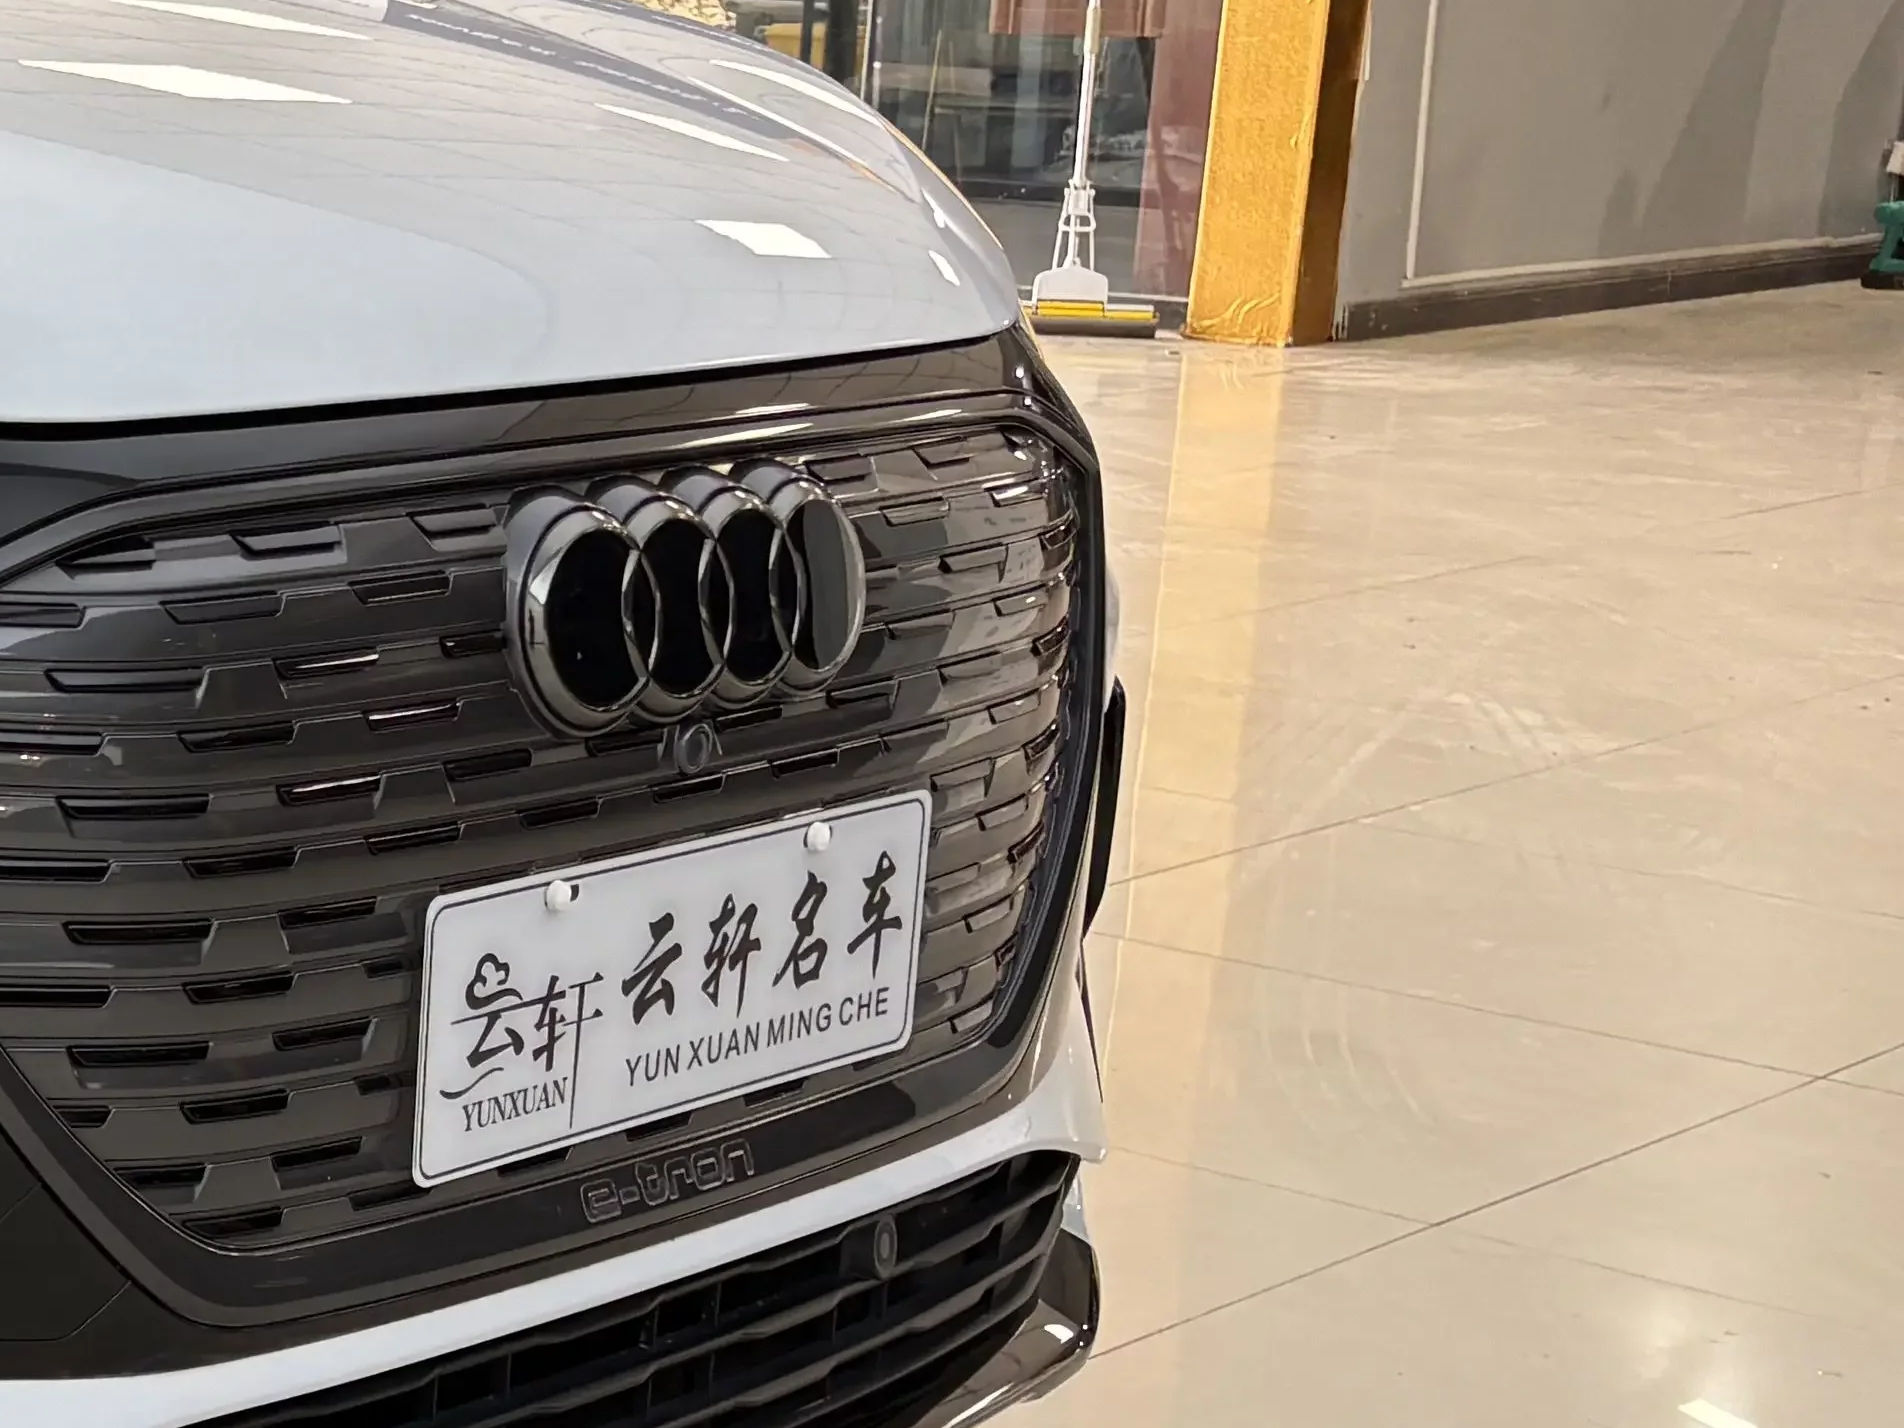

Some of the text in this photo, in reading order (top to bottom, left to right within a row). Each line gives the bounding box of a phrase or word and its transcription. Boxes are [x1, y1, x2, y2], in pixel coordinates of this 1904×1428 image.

[621, 849, 903, 1026] 云轩名车
[624, 988, 890, 1087] YUN XUAN MING CHE
[461, 1077, 568, 1133] YUNXUAN
[581, 1139, 755, 1224] e-tron
